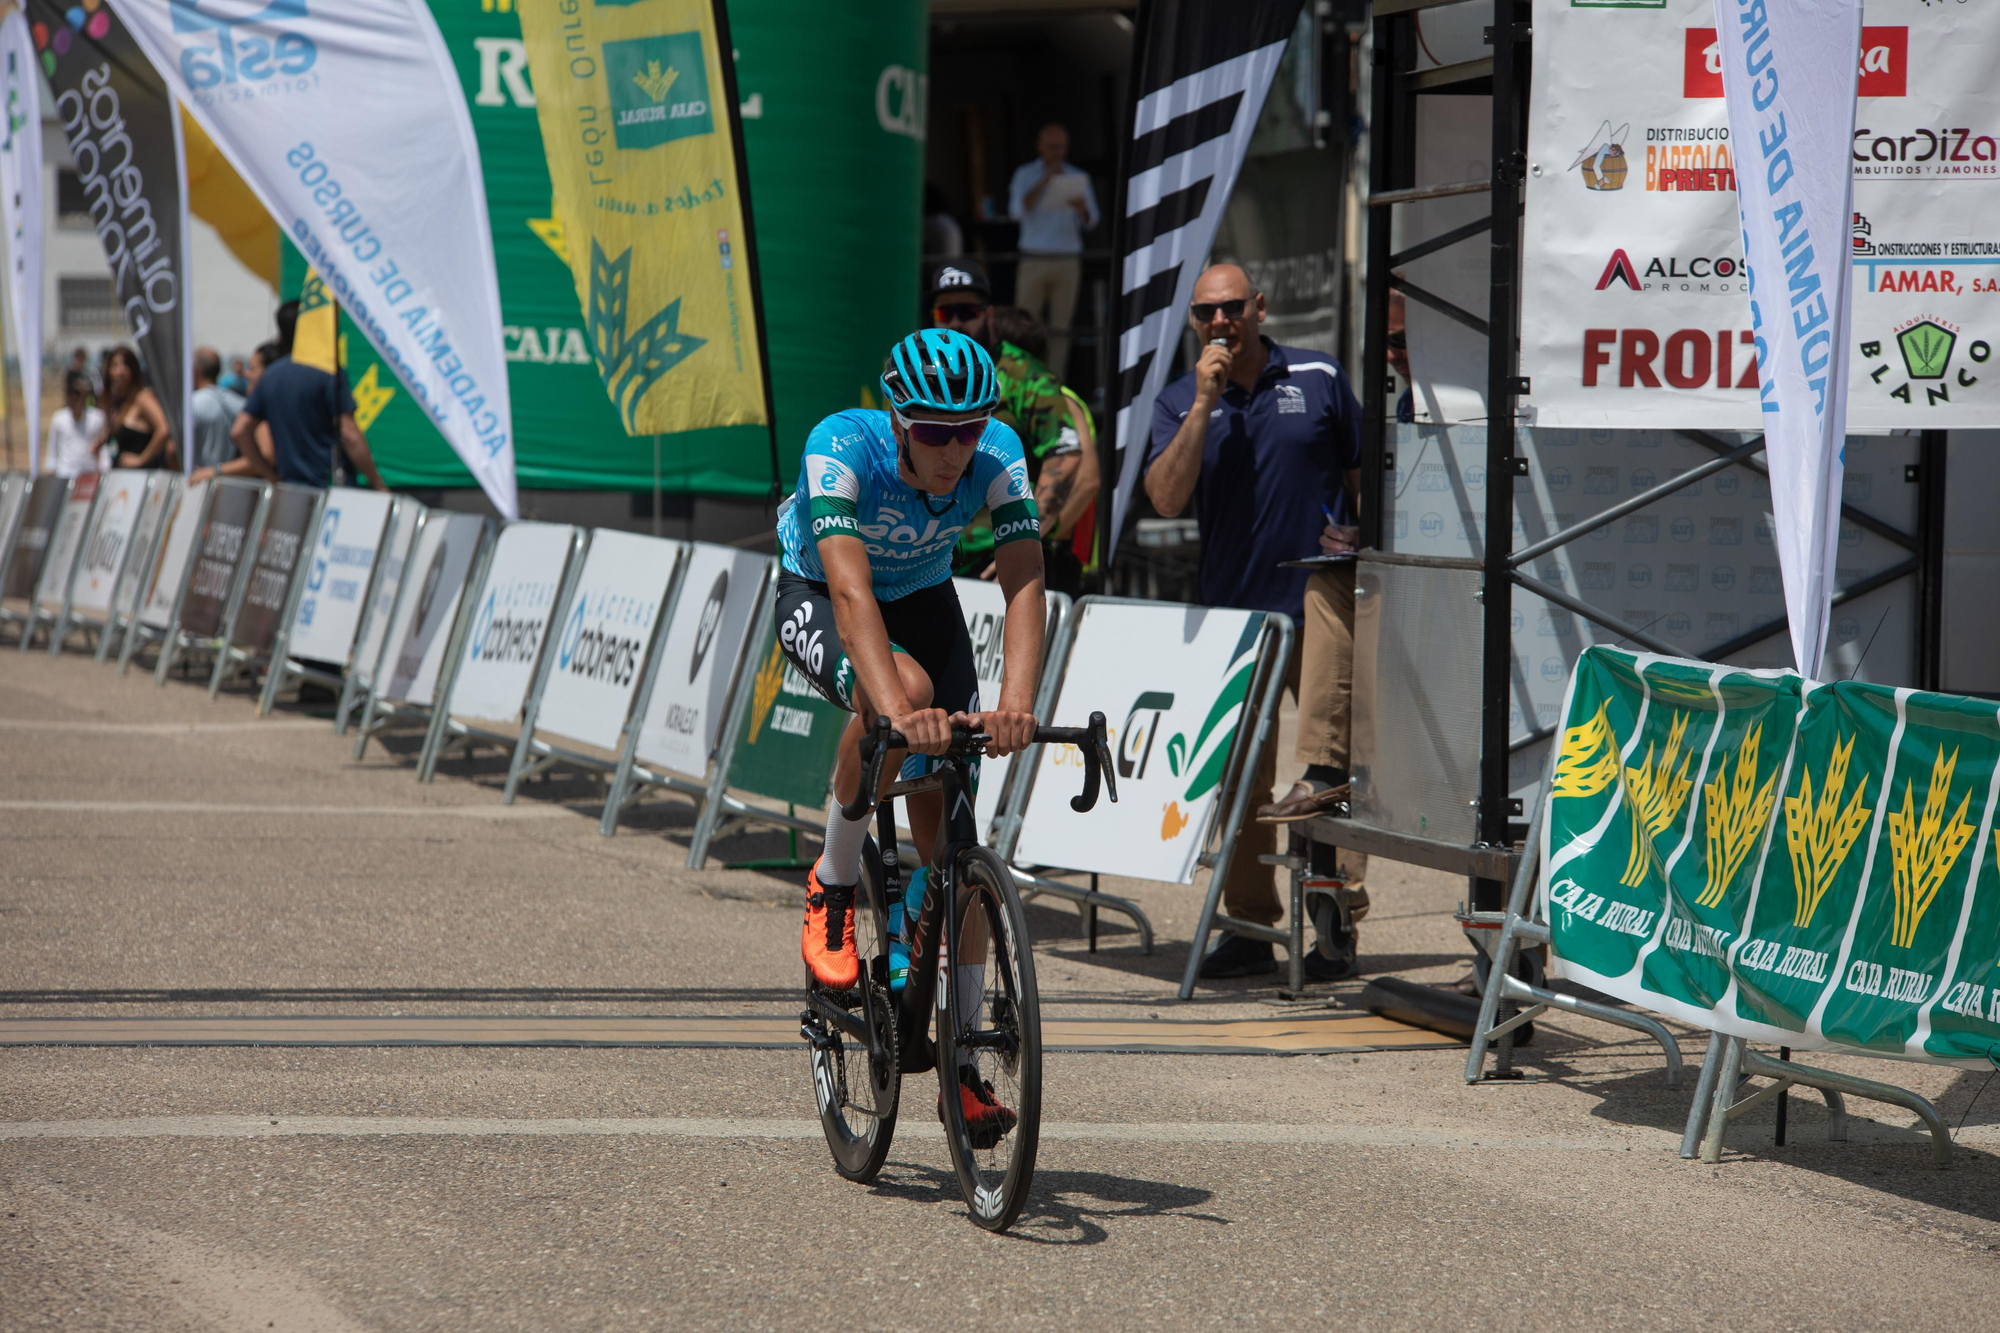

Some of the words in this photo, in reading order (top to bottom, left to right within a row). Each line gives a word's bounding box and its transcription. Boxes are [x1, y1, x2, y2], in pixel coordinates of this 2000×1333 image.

[1645, 143, 1735, 191] BARTOLO
[1926, 166, 1932, 174] Y
[1936, 165, 1997, 174] JAMONES
[1943, 243, 1950, 255] Y
[1893, 314, 1961, 333] ALQUILERES
[501, 326, 591, 364] CAJA
[1860, 340, 1991, 406] BLANCO
[863, 538, 952, 560] OMETA
[588, 585, 656, 629] LÁCTEAS
[781, 617, 824, 676] eolo
[771, 704, 786, 731] DE
[780, 706, 815, 738] ZAMORA
[1549, 879, 1602, 927] CAJA
[1601, 900, 1651, 938] RURAL
[1665, 917, 1693, 949] CAJA
[1693, 922, 1728, 959] RURAL
[1739, 938, 1776, 972] CAJA
[1776, 945, 1828, 984] RURAL
[1846, 959, 1882, 995] CAJA
[1884, 966, 1935, 1005] RURAL
[1942, 981, 1985, 1019] CAJA
